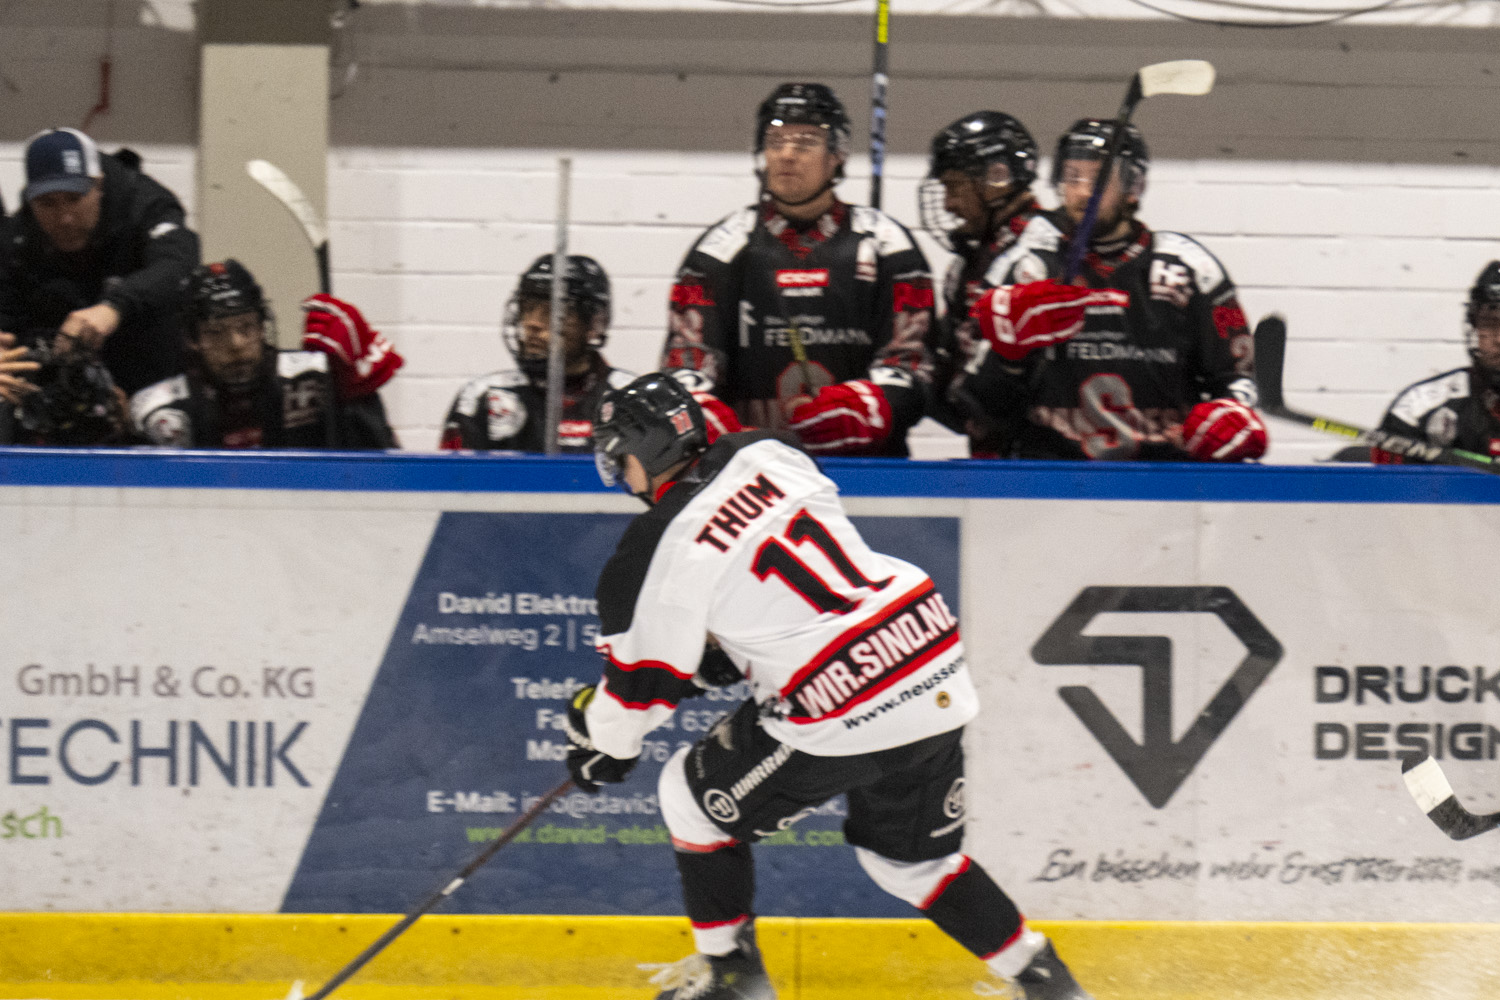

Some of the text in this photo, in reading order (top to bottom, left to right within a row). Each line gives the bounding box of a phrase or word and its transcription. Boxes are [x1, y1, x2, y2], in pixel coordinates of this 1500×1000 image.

[694, 472, 787, 553] THUM
[750, 507, 897, 616] 11
[438, 592, 512, 615] David
[411, 623, 539, 651] Amselweg
[544, 624, 561, 646] 2
[17, 664, 315, 699] GmbH & Co. KG
[0, 718, 312, 788] ECHNIK
[427, 790, 517, 813] E-Mail:
